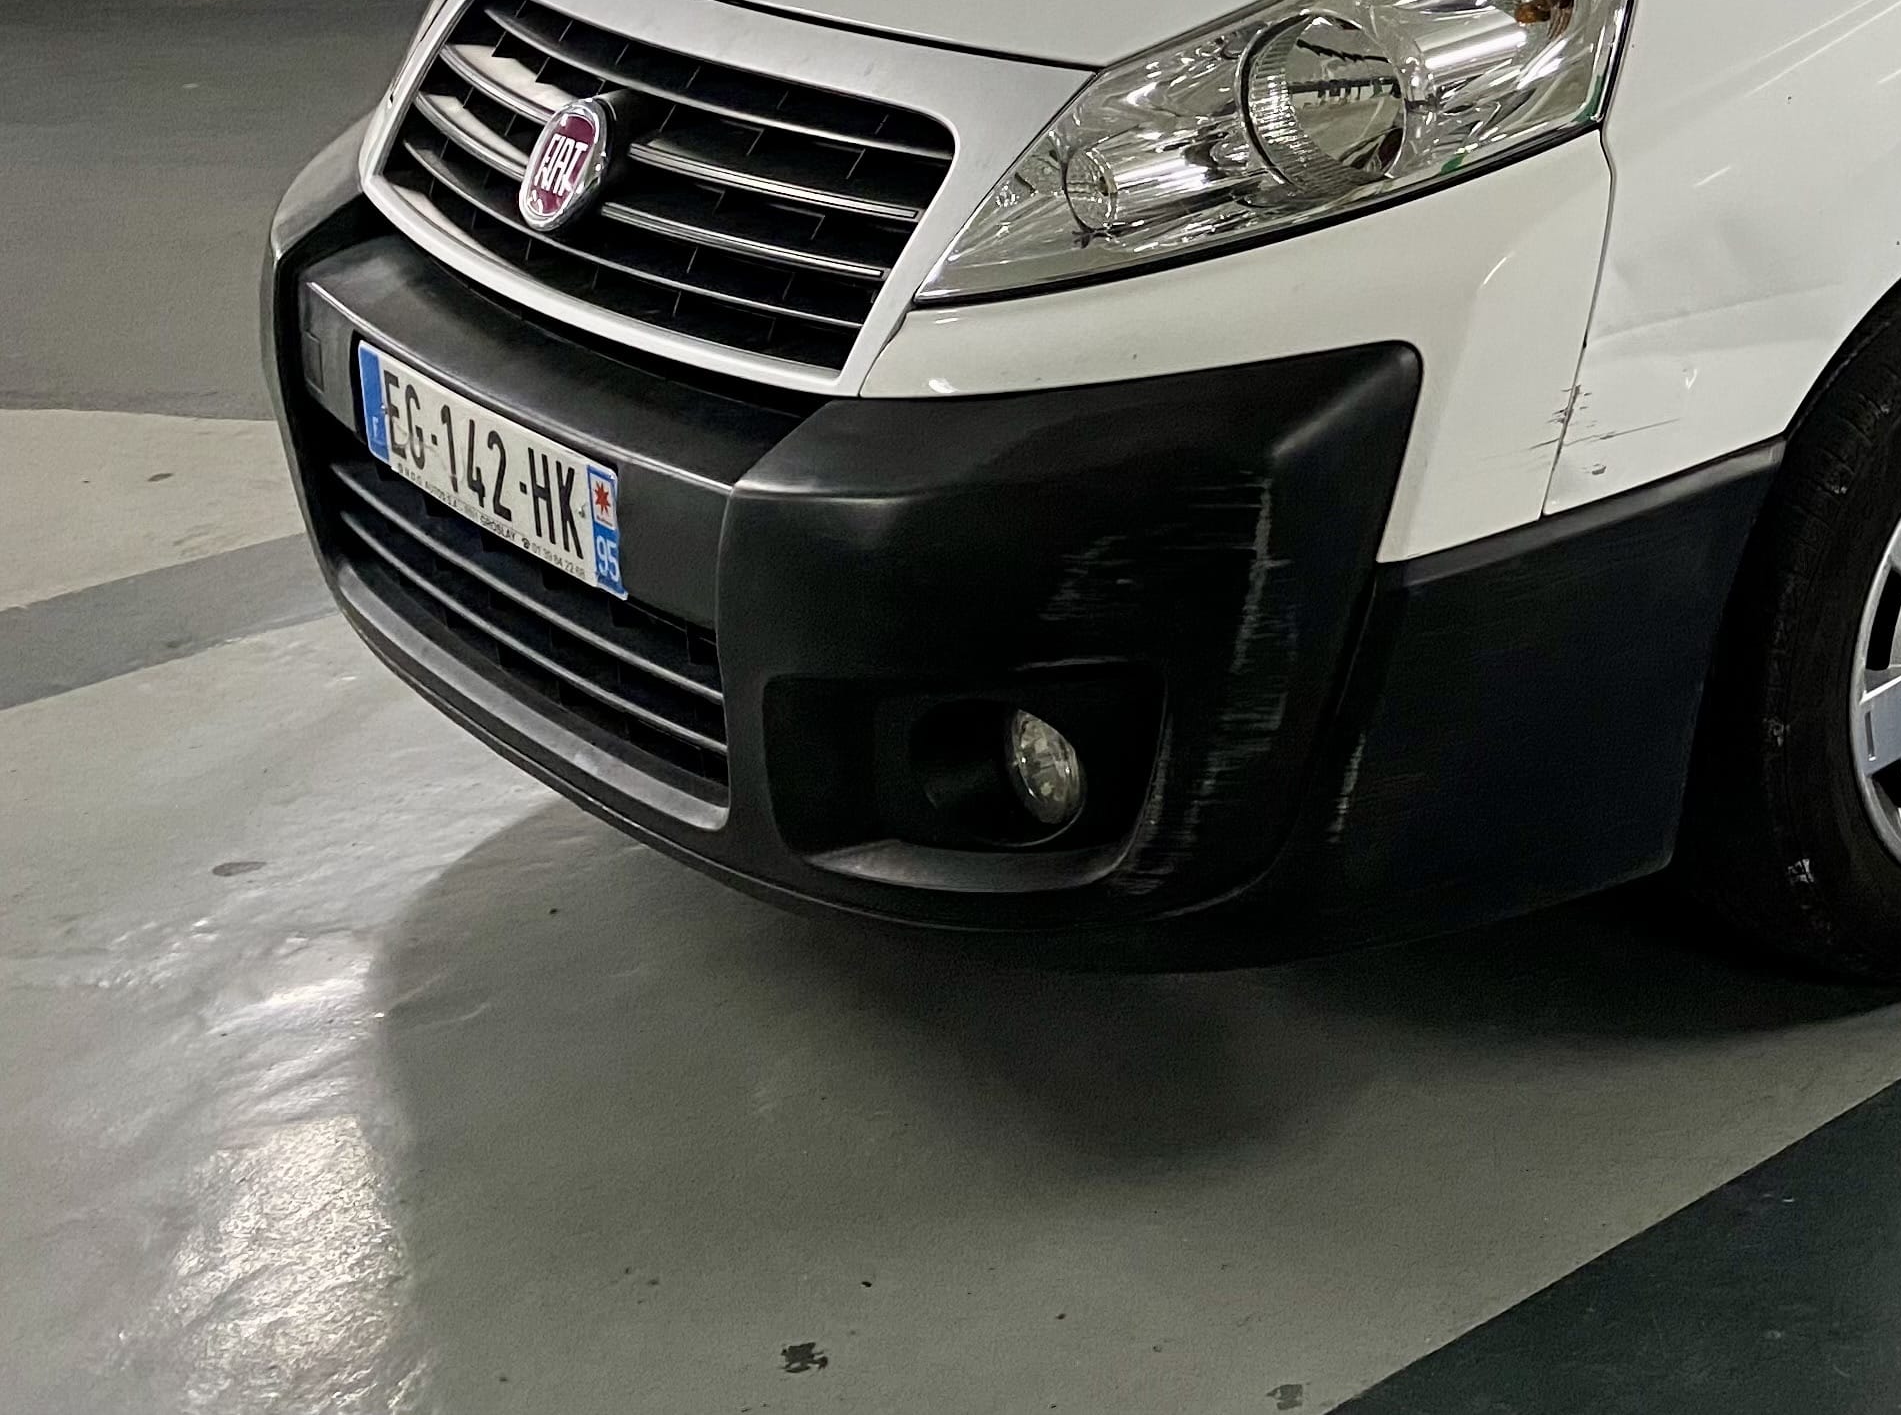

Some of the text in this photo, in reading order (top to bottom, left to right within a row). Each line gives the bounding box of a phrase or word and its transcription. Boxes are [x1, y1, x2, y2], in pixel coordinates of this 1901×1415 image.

[534, 133, 589, 196] FIAT
[383, 369, 584, 559] EG-142-HK
[596, 534, 619, 583] 95
